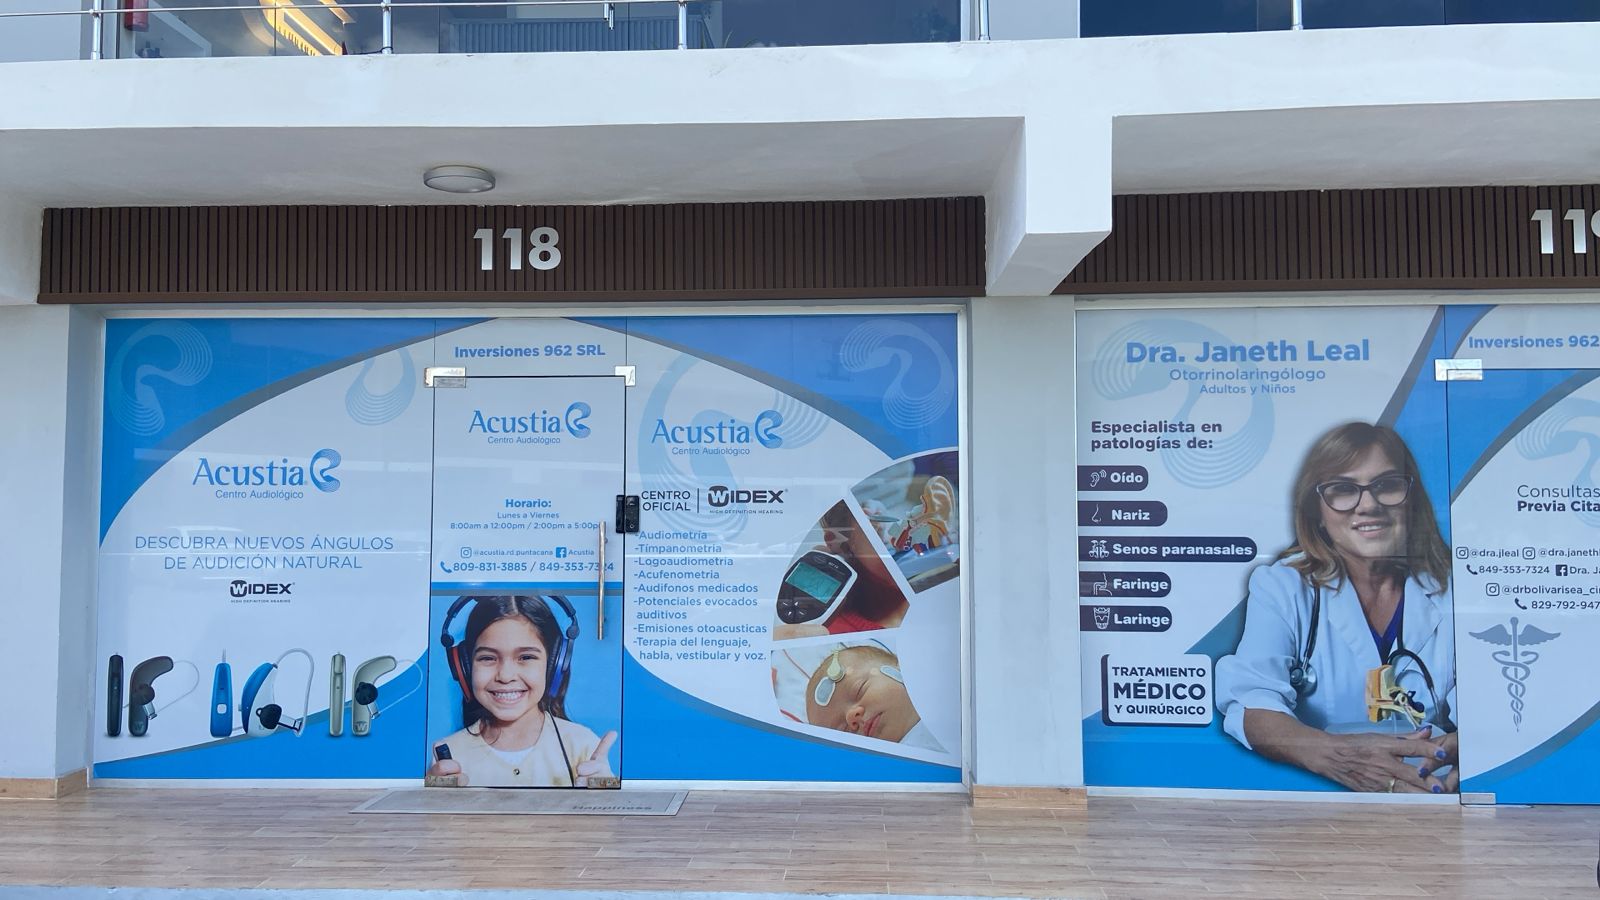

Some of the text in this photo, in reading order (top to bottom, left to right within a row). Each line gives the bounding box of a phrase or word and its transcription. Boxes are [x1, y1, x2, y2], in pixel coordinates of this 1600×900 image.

[473, 226, 561, 270] 118
[1468, 335, 1600, 348] Inversiones 962
[455, 344, 606, 358] Inversiones 962 SRL
[1126, 338, 1370, 363] Dra. Janeth Leal
[1169, 367, 1326, 382] Otorrinolaringólogo
[1199, 383, 1296, 396] Adultos y Niños
[468, 409, 561, 434] Acustia
[1091, 420, 1223, 436] Especialista en
[651, 418, 750, 444] Acustia
[487, 436, 561, 446] Centro Audiológico
[1091, 436, 1214, 452] patologías de:
[671, 446, 751, 457] Centro Audiológico
[192, 457, 305, 487] Acustia
[1110, 472, 1144, 483] Oído
[215, 489, 304, 501] Centro Audiológico
[641, 485, 785, 508] CENTRO WIDEX
[1517, 484, 1600, 498] Consultas
[505, 498, 552, 508] Horario:
[642, 501, 691, 511] OFICIAL
[1517, 500, 1600, 512] Previa Cita
[1111, 509, 1150, 521] Nariz
[450, 522, 482, 530] 8:00am
[490, 522, 525, 531] 12:00pm
[526, 522, 531, 531] /
[533, 522, 565, 531] 2:00pm
[574, 522, 601, 531] 5:00p
[134, 534, 395, 550] DESCUBRA NUEVOS ÁNGULOS
[1112, 543, 1253, 557] Senos paranasales
[1471, 548, 1520, 559] @dra.jleal
[164, 553, 363, 570] DE AUDICIÓN NATURAL
[453, 562, 527, 571] 809-831-3885
[530, 561, 537, 572] /
[1479, 565, 1550, 574] 849-353-7324
[1569, 566, 1590, 575] Dra.
[230, 579, 292, 597] WIDEX
[697, 583, 759, 593] medicados
[1113, 578, 1169, 592] Faringe
[633, 596, 758, 606] -Potenciales evocados
[636, 610, 688, 620] auditivos
[1114, 613, 1170, 627] Laringe
[633, 623, 768, 633] -Emisiones otoacusticas
[633, 637, 751, 648] -Terapia del lenguaje,
[639, 650, 673, 661] habla,
[676, 650, 731, 660] vestibular
[733, 653, 741, 662] y
[1112, 666, 1206, 678] TRATAMIENTO
[1113, 678, 1206, 700] MÉDICO
[1114, 702, 1206, 716] Y QUIRÚRGICO
